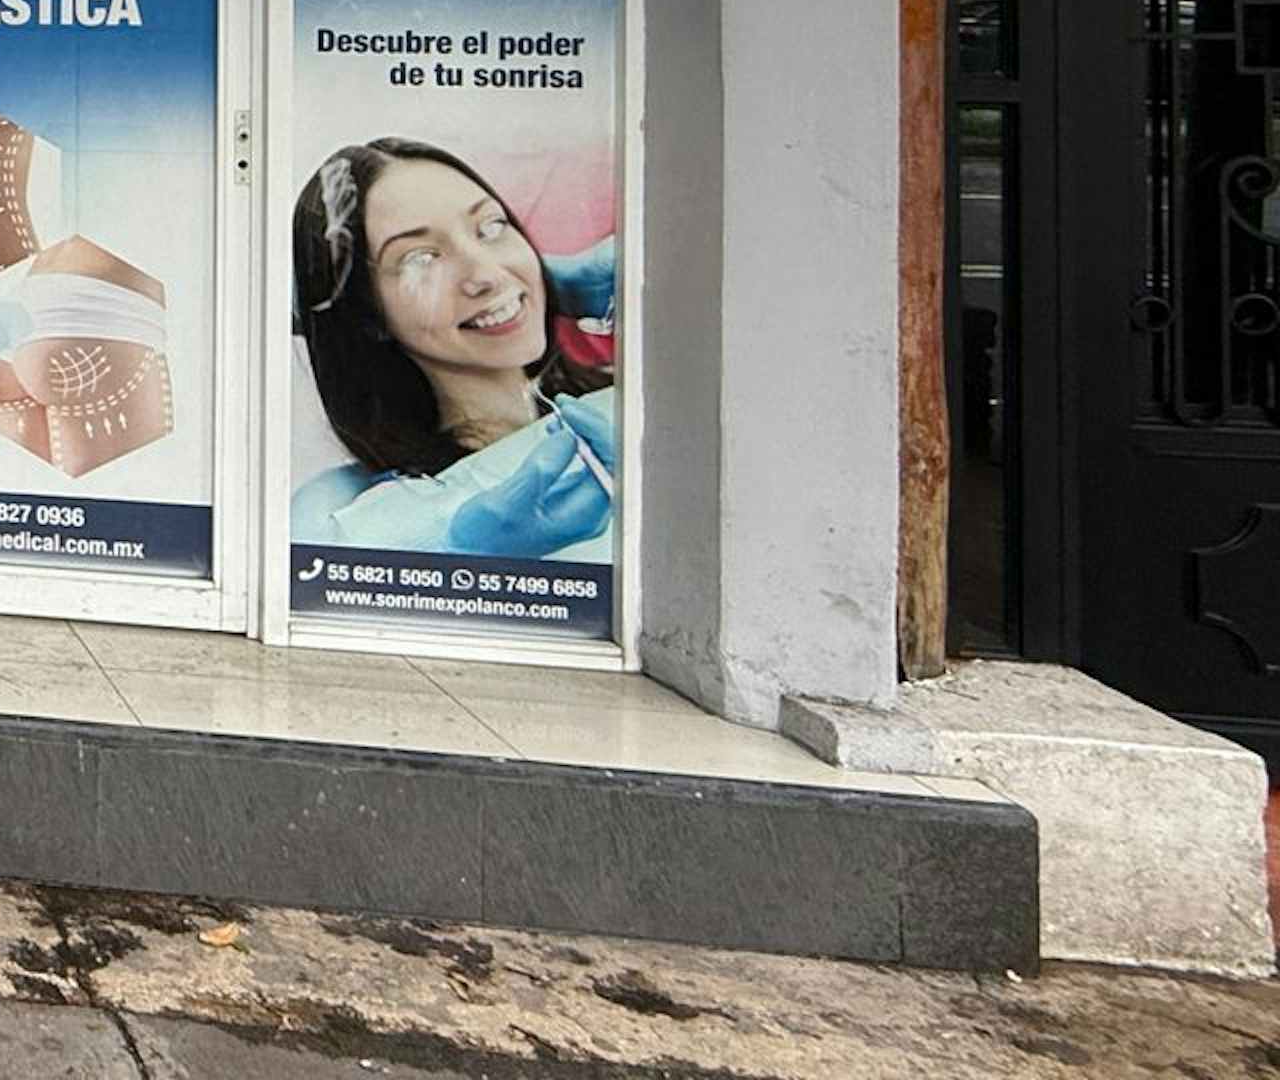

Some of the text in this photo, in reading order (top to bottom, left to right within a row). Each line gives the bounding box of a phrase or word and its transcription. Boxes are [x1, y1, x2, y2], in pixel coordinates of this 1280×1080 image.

[317, 29, 585, 60] Descubre el poder
[390, 63, 584, 89] de tu sonrisa
[36, 504, 86, 527] 0936
[327, 564, 598, 599] 55 6821 5050 55 7499 6858
[325, 588, 569, 620] www.sonrimexpolanco.com
